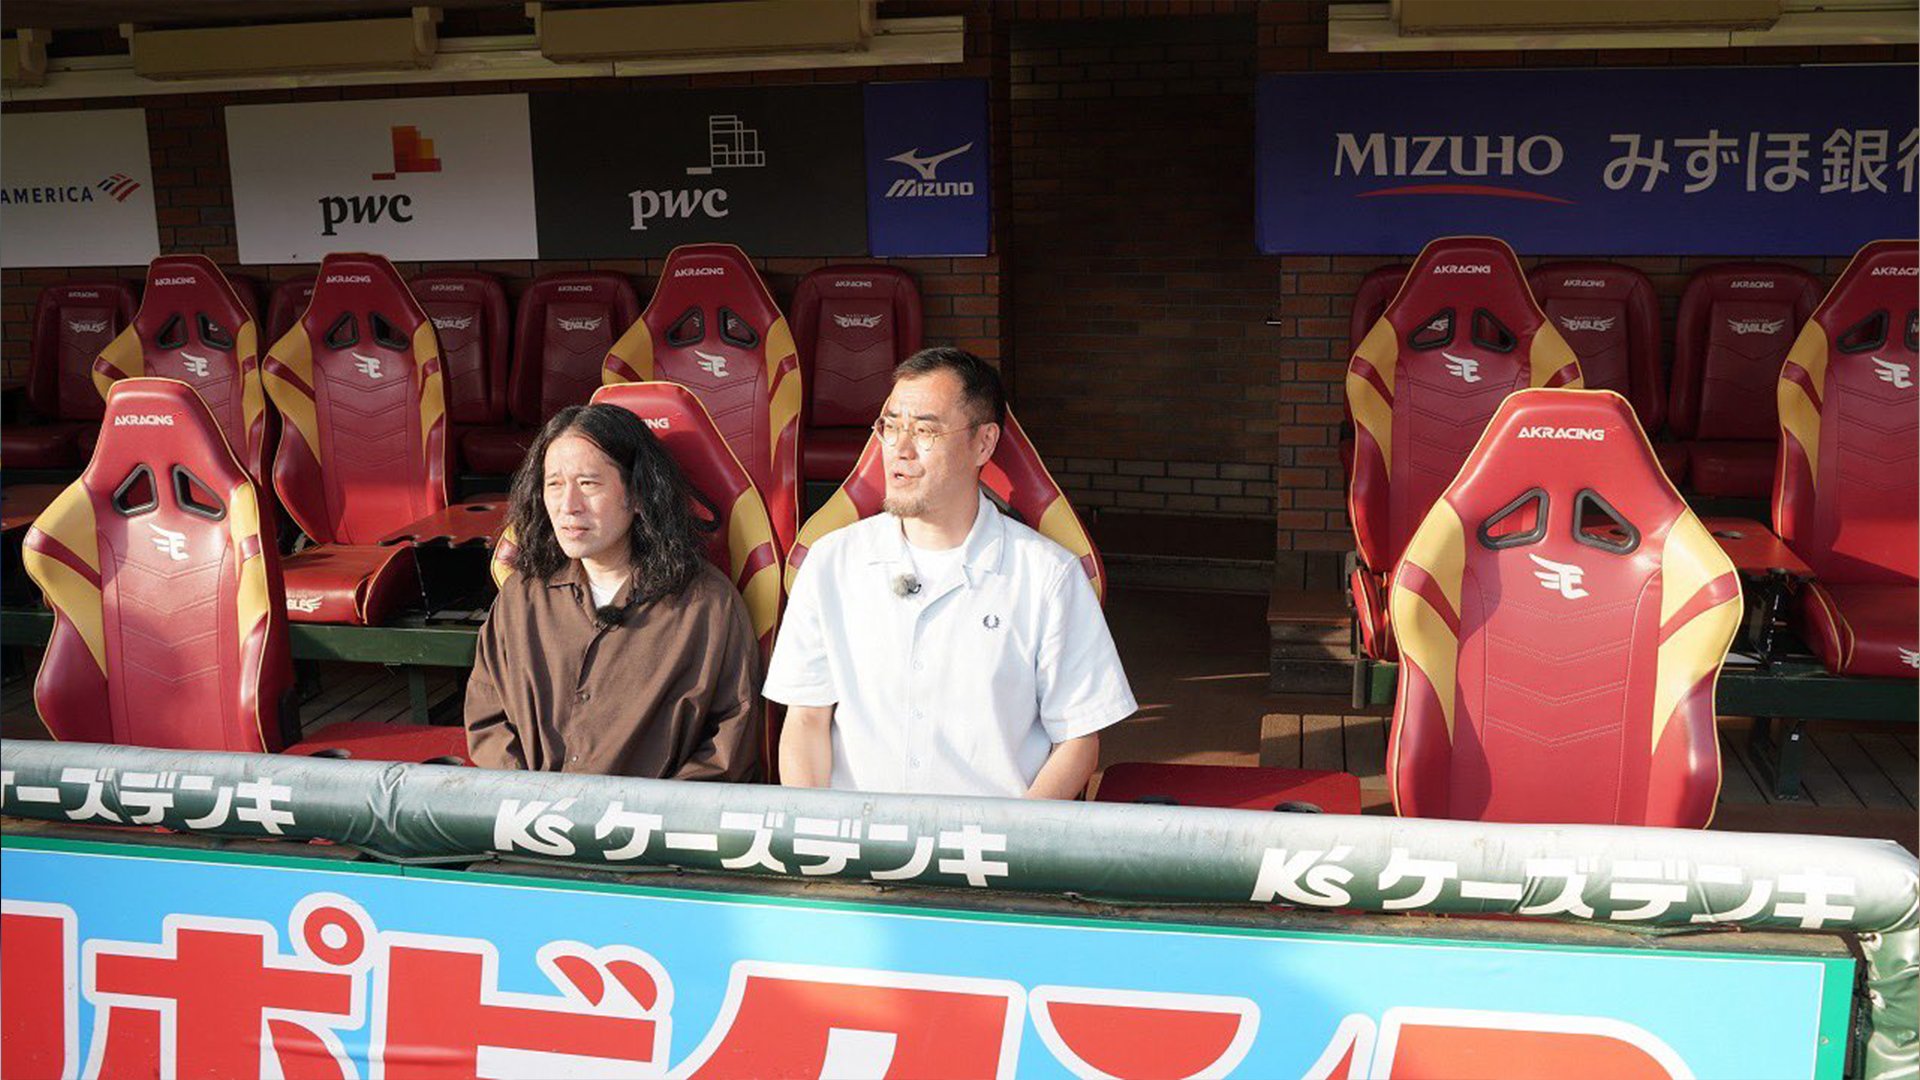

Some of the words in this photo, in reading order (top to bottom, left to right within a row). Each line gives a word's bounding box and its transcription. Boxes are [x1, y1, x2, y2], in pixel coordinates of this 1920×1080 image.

[1334, 133, 1565, 176] MIZUHO
[1, 187, 94, 205] AMERICA
[628, 187, 729, 230] pwc
[318, 194, 414, 236] pwc
[673, 267, 725, 278] AKRACING
[1433, 264, 1491, 274] AKRACING
[114, 414, 175, 427] AKRACING
[1517, 426, 1605, 441] AKRACING
[595, 802, 1009, 888] ケーズデンキ
[1378, 847, 1856, 930] ケーズデンキ
